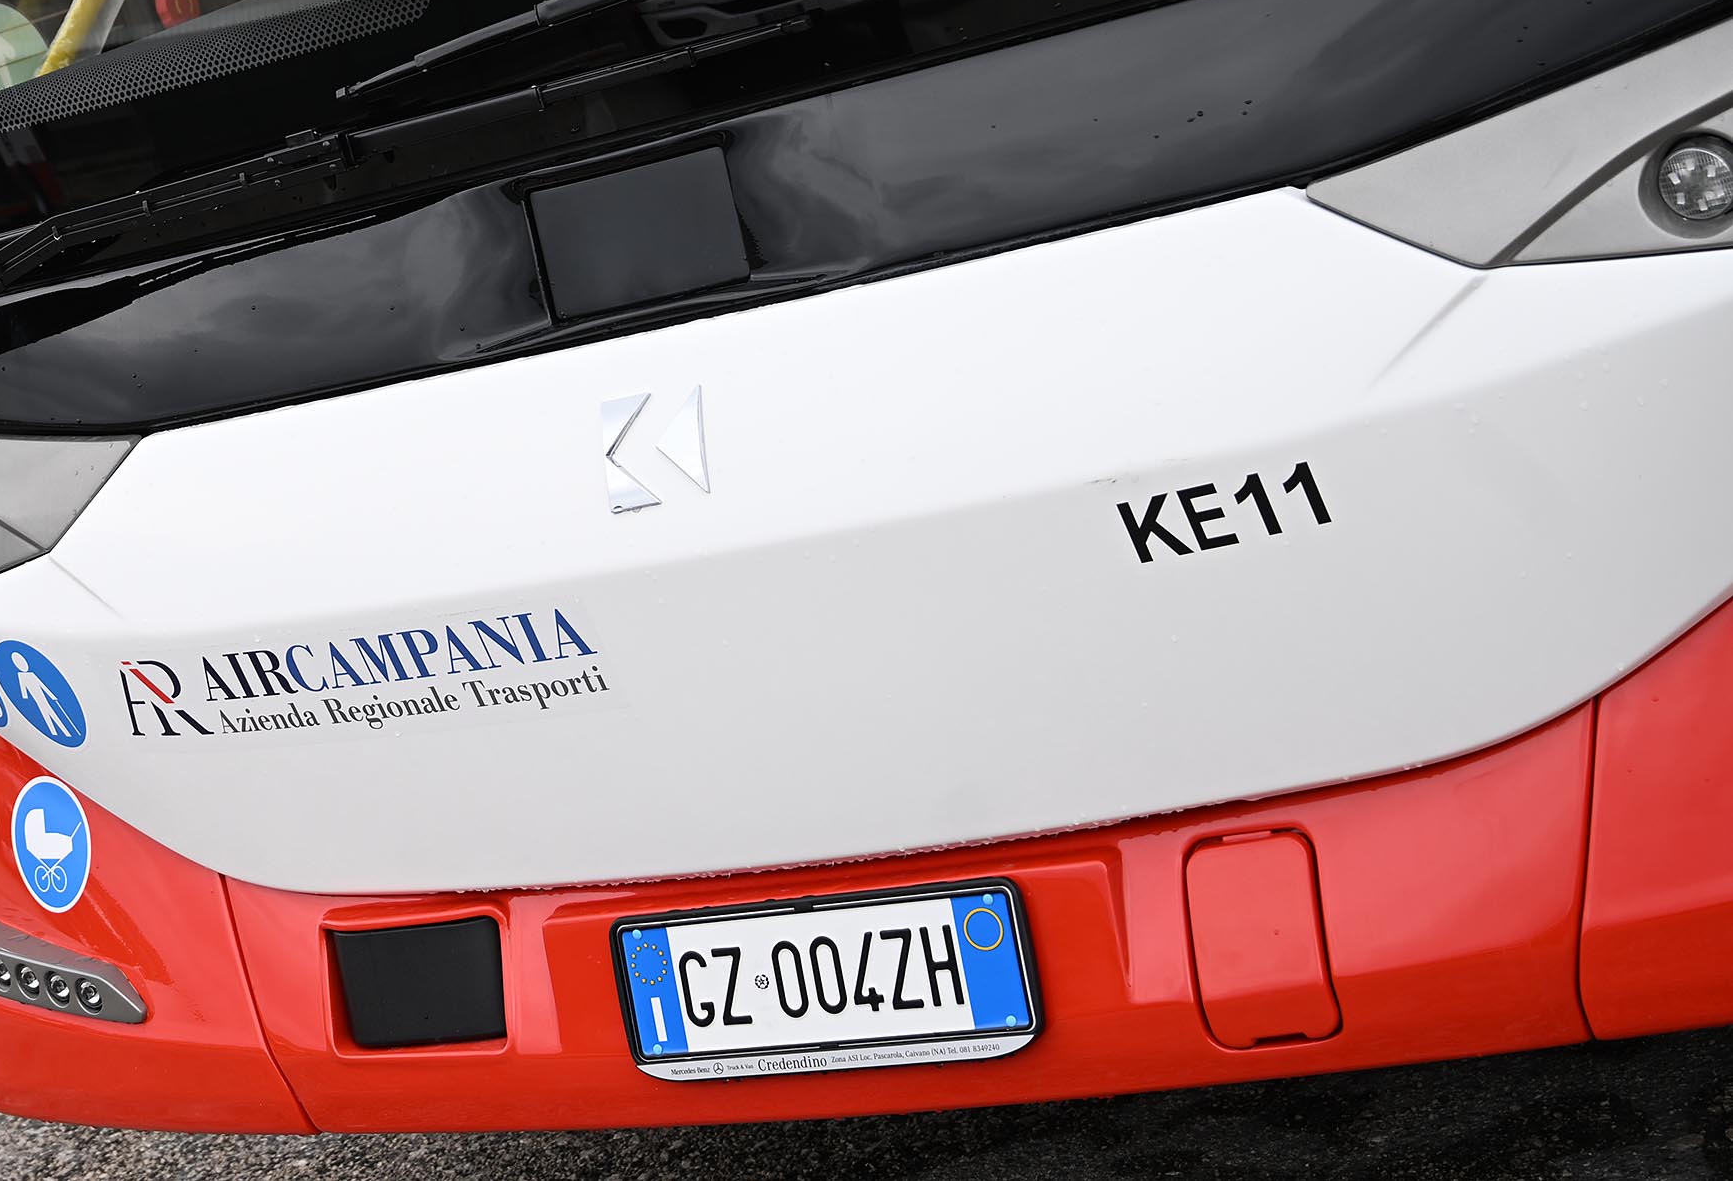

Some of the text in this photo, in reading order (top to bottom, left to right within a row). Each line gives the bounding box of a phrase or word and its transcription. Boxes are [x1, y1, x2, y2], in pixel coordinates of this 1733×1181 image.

[1116, 460, 1332, 564] KE11
[201, 607, 598, 702] AIRCAMPANIA
[220, 664, 610, 735] Azienda Regionale Trasporti
[670, 1066, 711, 1076] Mercedes-Benz
[757, 1055, 828, 1073] Credendino
[831, 1055, 847, 1064] Zona
[847, 1054, 859, 1062] ASI
[905, 1049, 931, 1058] Caivano
[931, 1047, 946, 1057] (NA)
[959, 1045, 971, 1054] 081
[972, 1043, 1000, 1053] 8349240
